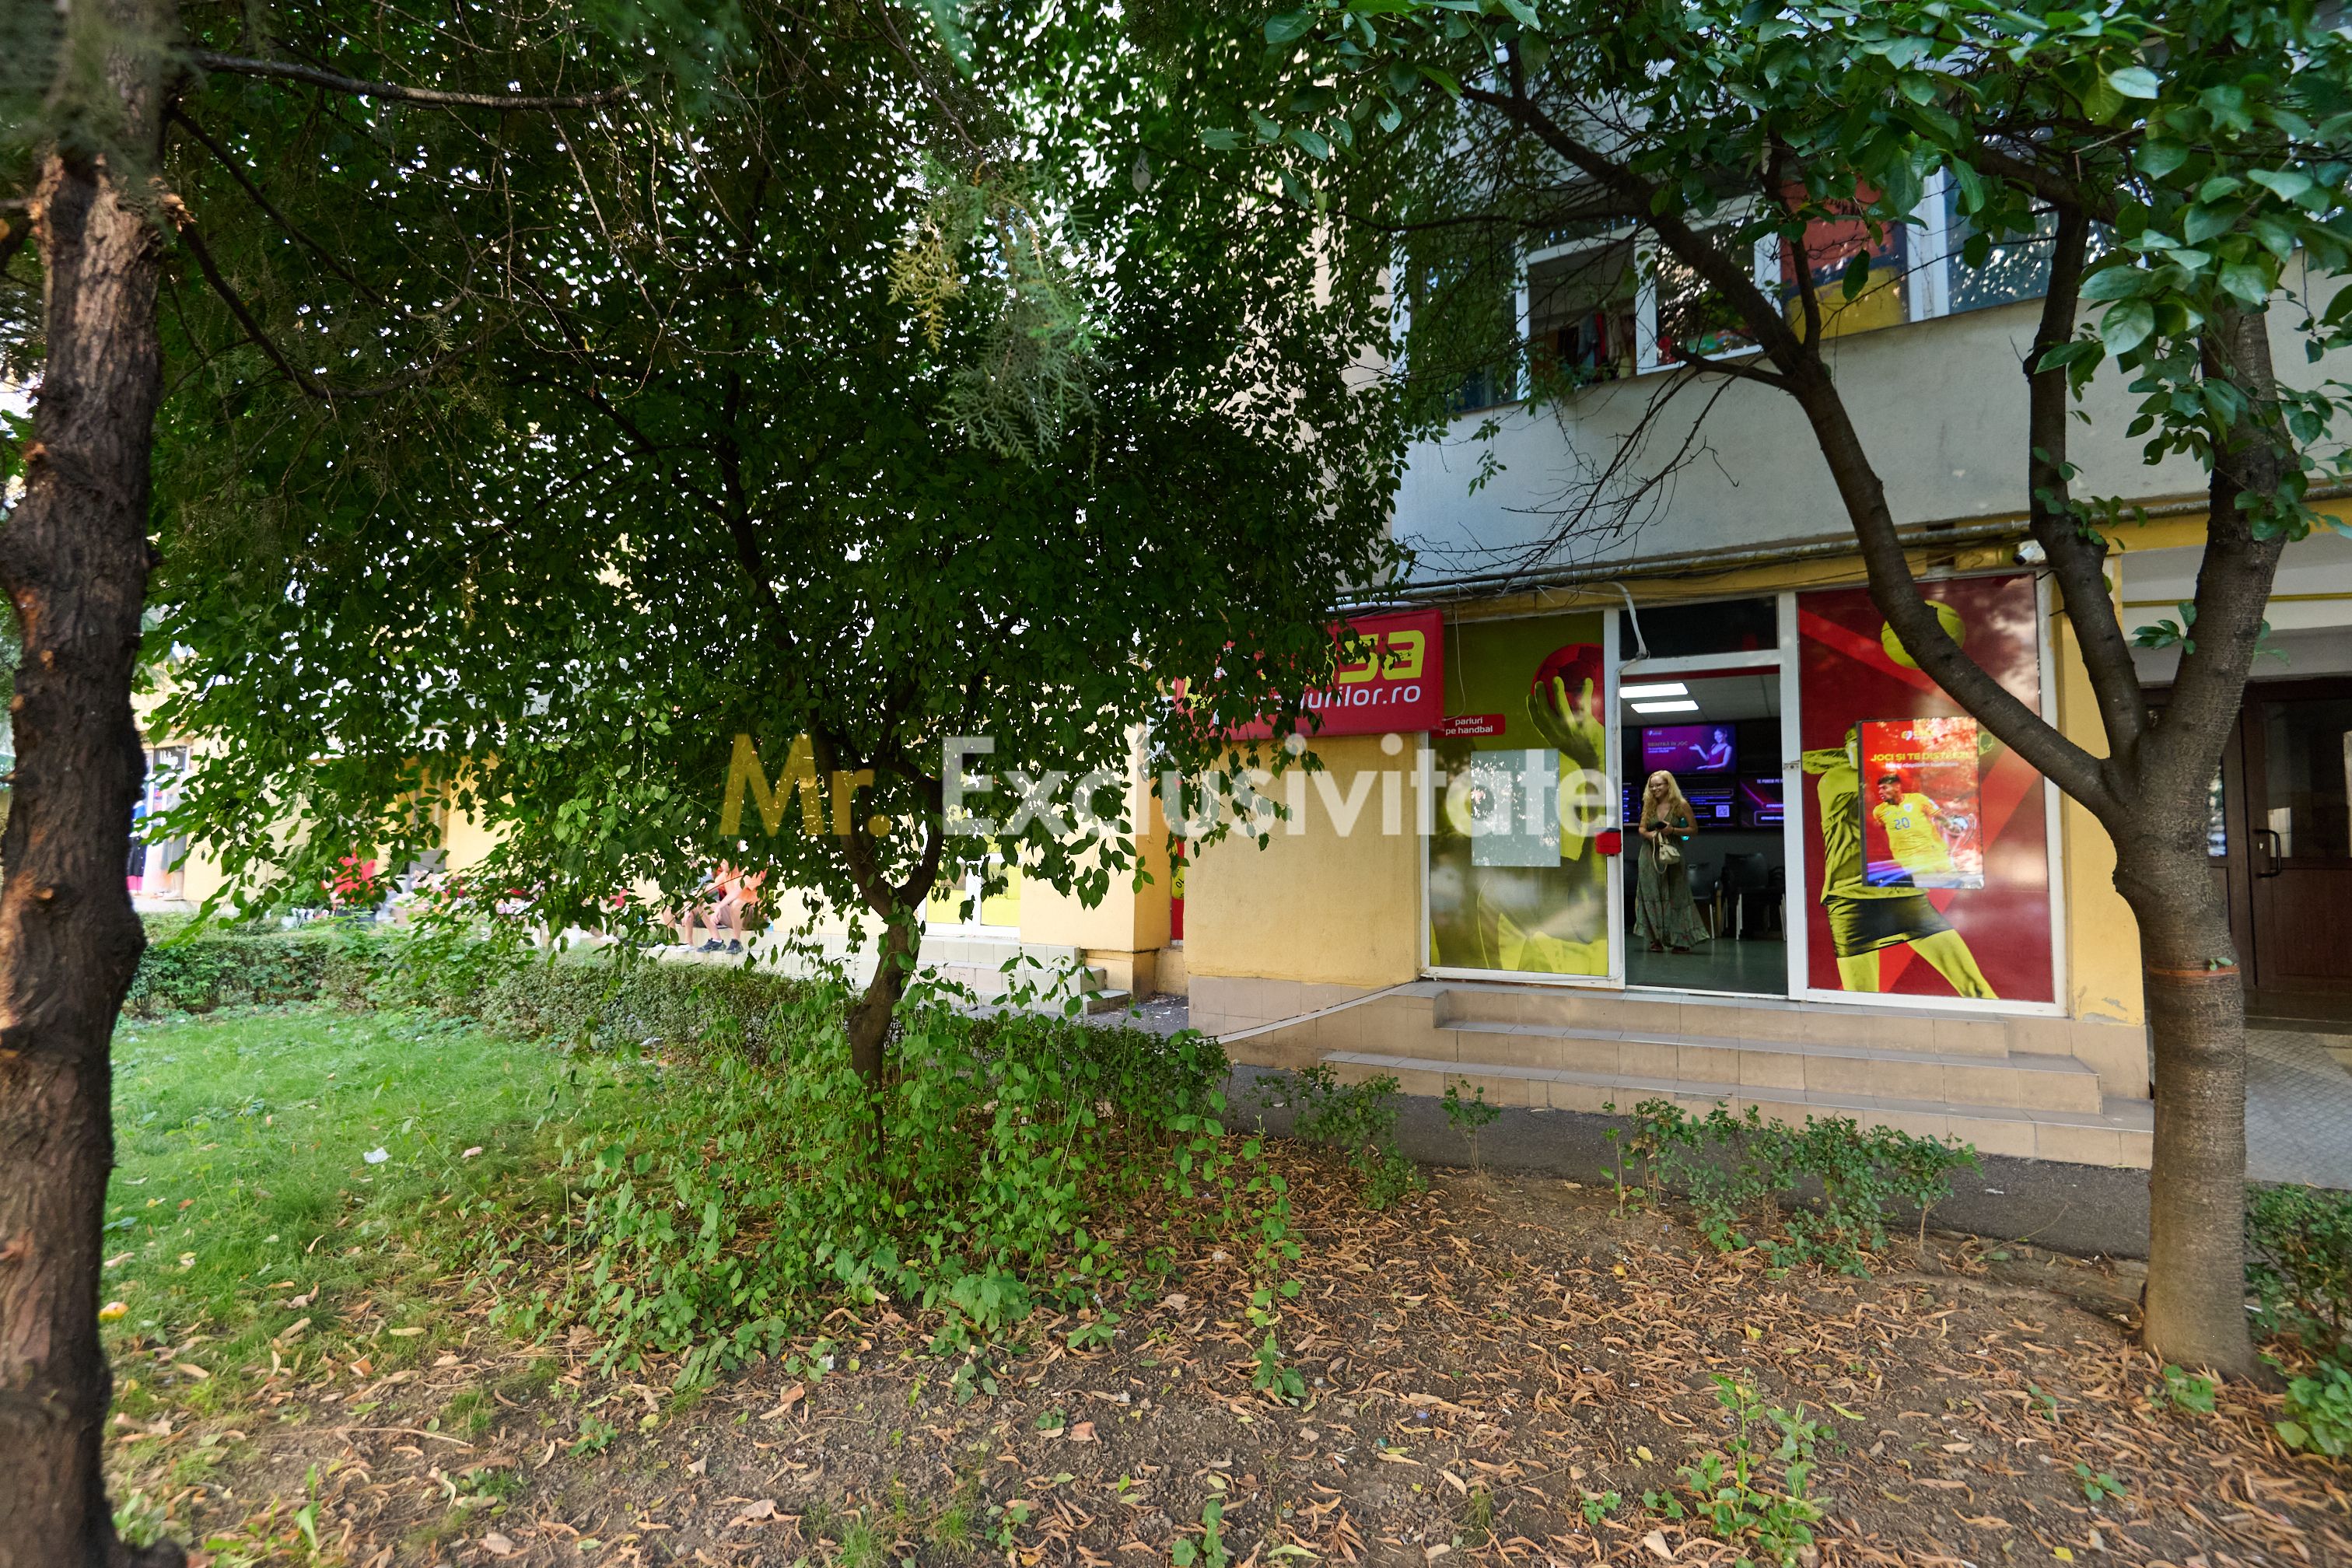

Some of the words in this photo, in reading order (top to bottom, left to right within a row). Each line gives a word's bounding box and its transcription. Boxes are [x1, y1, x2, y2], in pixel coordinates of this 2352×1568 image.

[1455, 716, 1483, 726] pariuri
[1445, 728, 1457, 737] pe
[1458, 725, 1493, 734] handbal
[1871, 753, 1894, 761] JOCI
[1907, 752, 1920, 761] TE
[1894, 817, 1910, 830] 20
